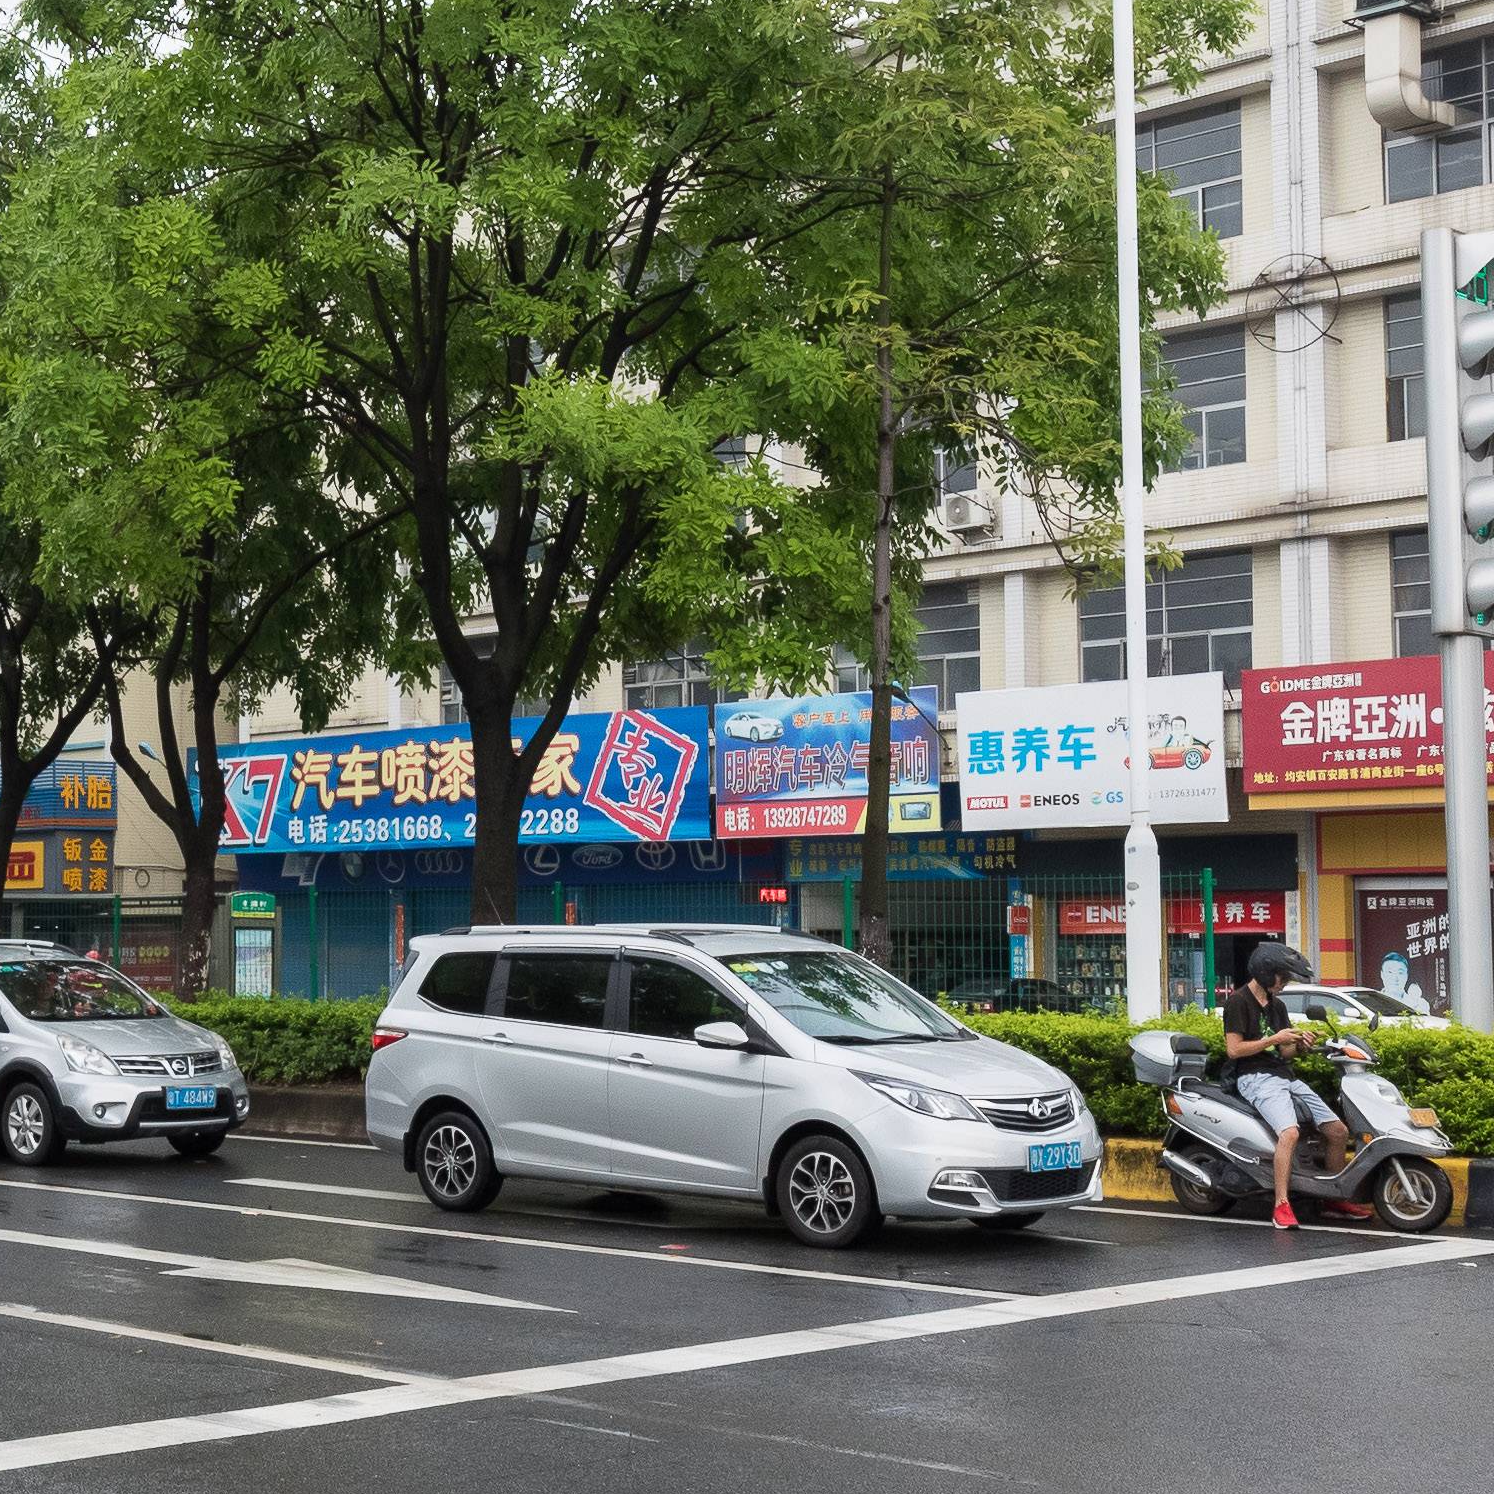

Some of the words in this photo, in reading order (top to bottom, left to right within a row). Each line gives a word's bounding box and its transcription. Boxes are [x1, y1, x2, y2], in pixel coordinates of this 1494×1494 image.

[792, 708, 850, 727] 客户至上
[967, 724, 1097, 775] 惠养车
[1322, 746, 1403, 763] 广东省著名商标
[291, 732, 581, 811] 汽车喷漆家
[60, 774, 112, 810] 补胎
[967, 796, 1008, 811] MOTUL
[1033, 792, 1081, 807] ENEOS
[1106, 791, 1124, 804] GS
[763, 804, 848, 829] 13928747289
[63, 837, 108, 862] 钣金
[63, 867, 108, 893] 喷漆
[1086, 904, 1126, 925] ENE
